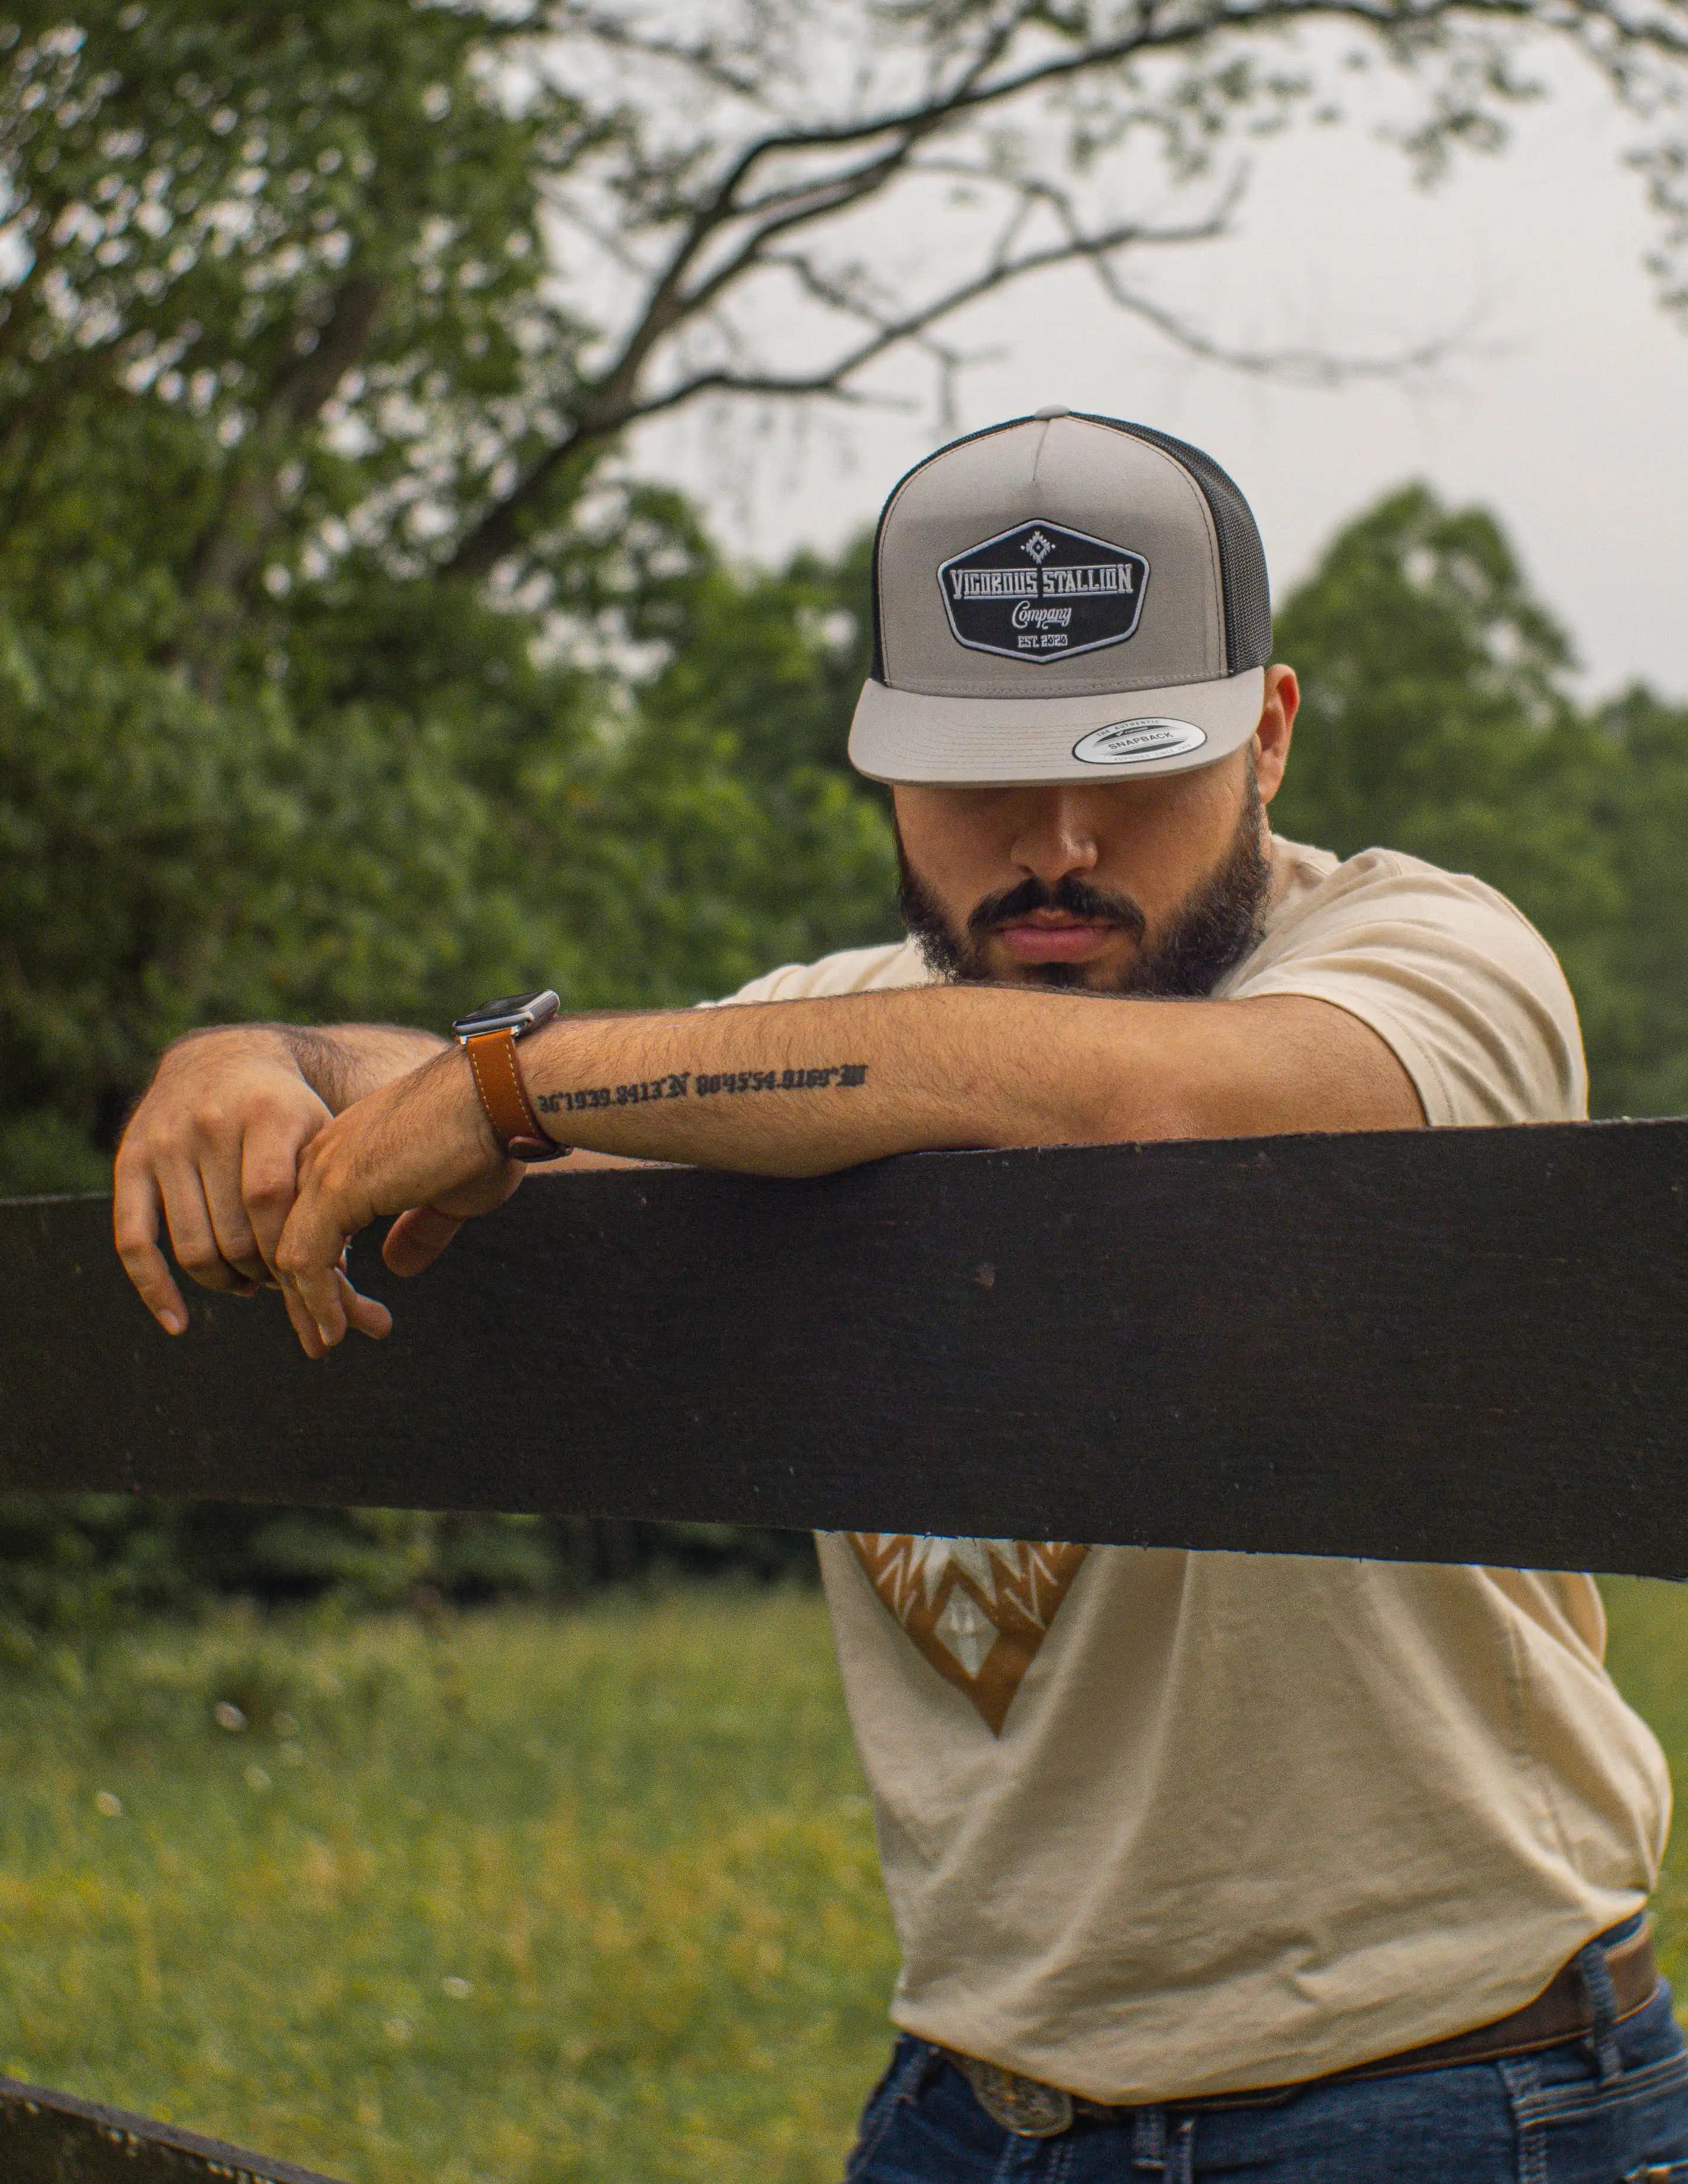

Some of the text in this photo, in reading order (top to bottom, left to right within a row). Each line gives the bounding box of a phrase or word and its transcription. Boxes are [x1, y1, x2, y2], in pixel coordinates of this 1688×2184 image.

[950, 563, 1133, 599] VIGOROUS STALLION
[1012, 601, 1071, 630] Company
[1041, 634, 1068, 647] 2020
[1115, 720, 1160, 730] AUTHENTIC
[1109, 732, 1174, 750] SNAPBACK
